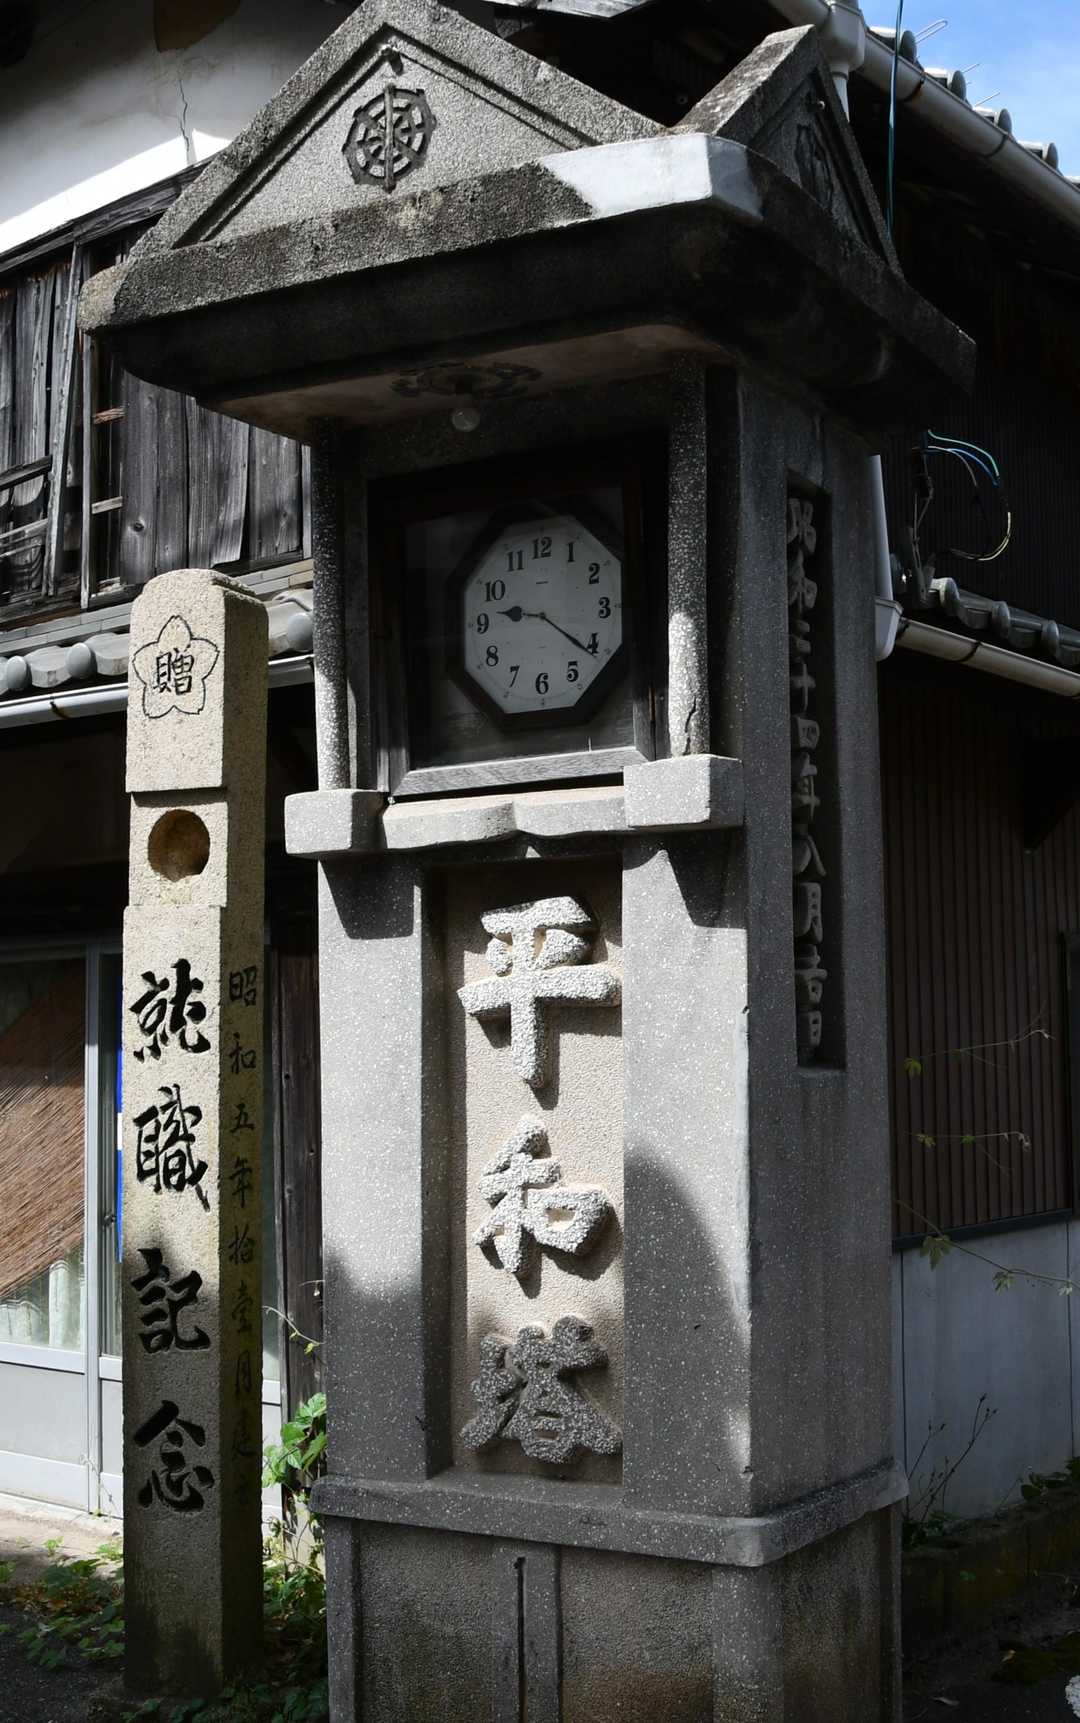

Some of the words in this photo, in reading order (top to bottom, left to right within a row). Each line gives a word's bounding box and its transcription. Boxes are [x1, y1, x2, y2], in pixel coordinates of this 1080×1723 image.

[532, 537, 552, 559] 12
[567, 542, 576, 562] 1
[507, 550, 525, 571] 11
[588, 563, 600, 584] 2
[485, 580, 506, 601] 10
[599, 597, 611, 618] 3
[477, 613, 489, 634] 9
[587, 633, 599, 655] 4
[486, 646, 499, 666] 8
[154, 645, 194, 695] 贈
[510, 666, 520, 688] 7
[567, 661, 579, 682] 5
[535, 673, 549, 694] 6
[457, 895, 622, 1464] 平和塔
[130, 958, 214, 1512] 就職記念
